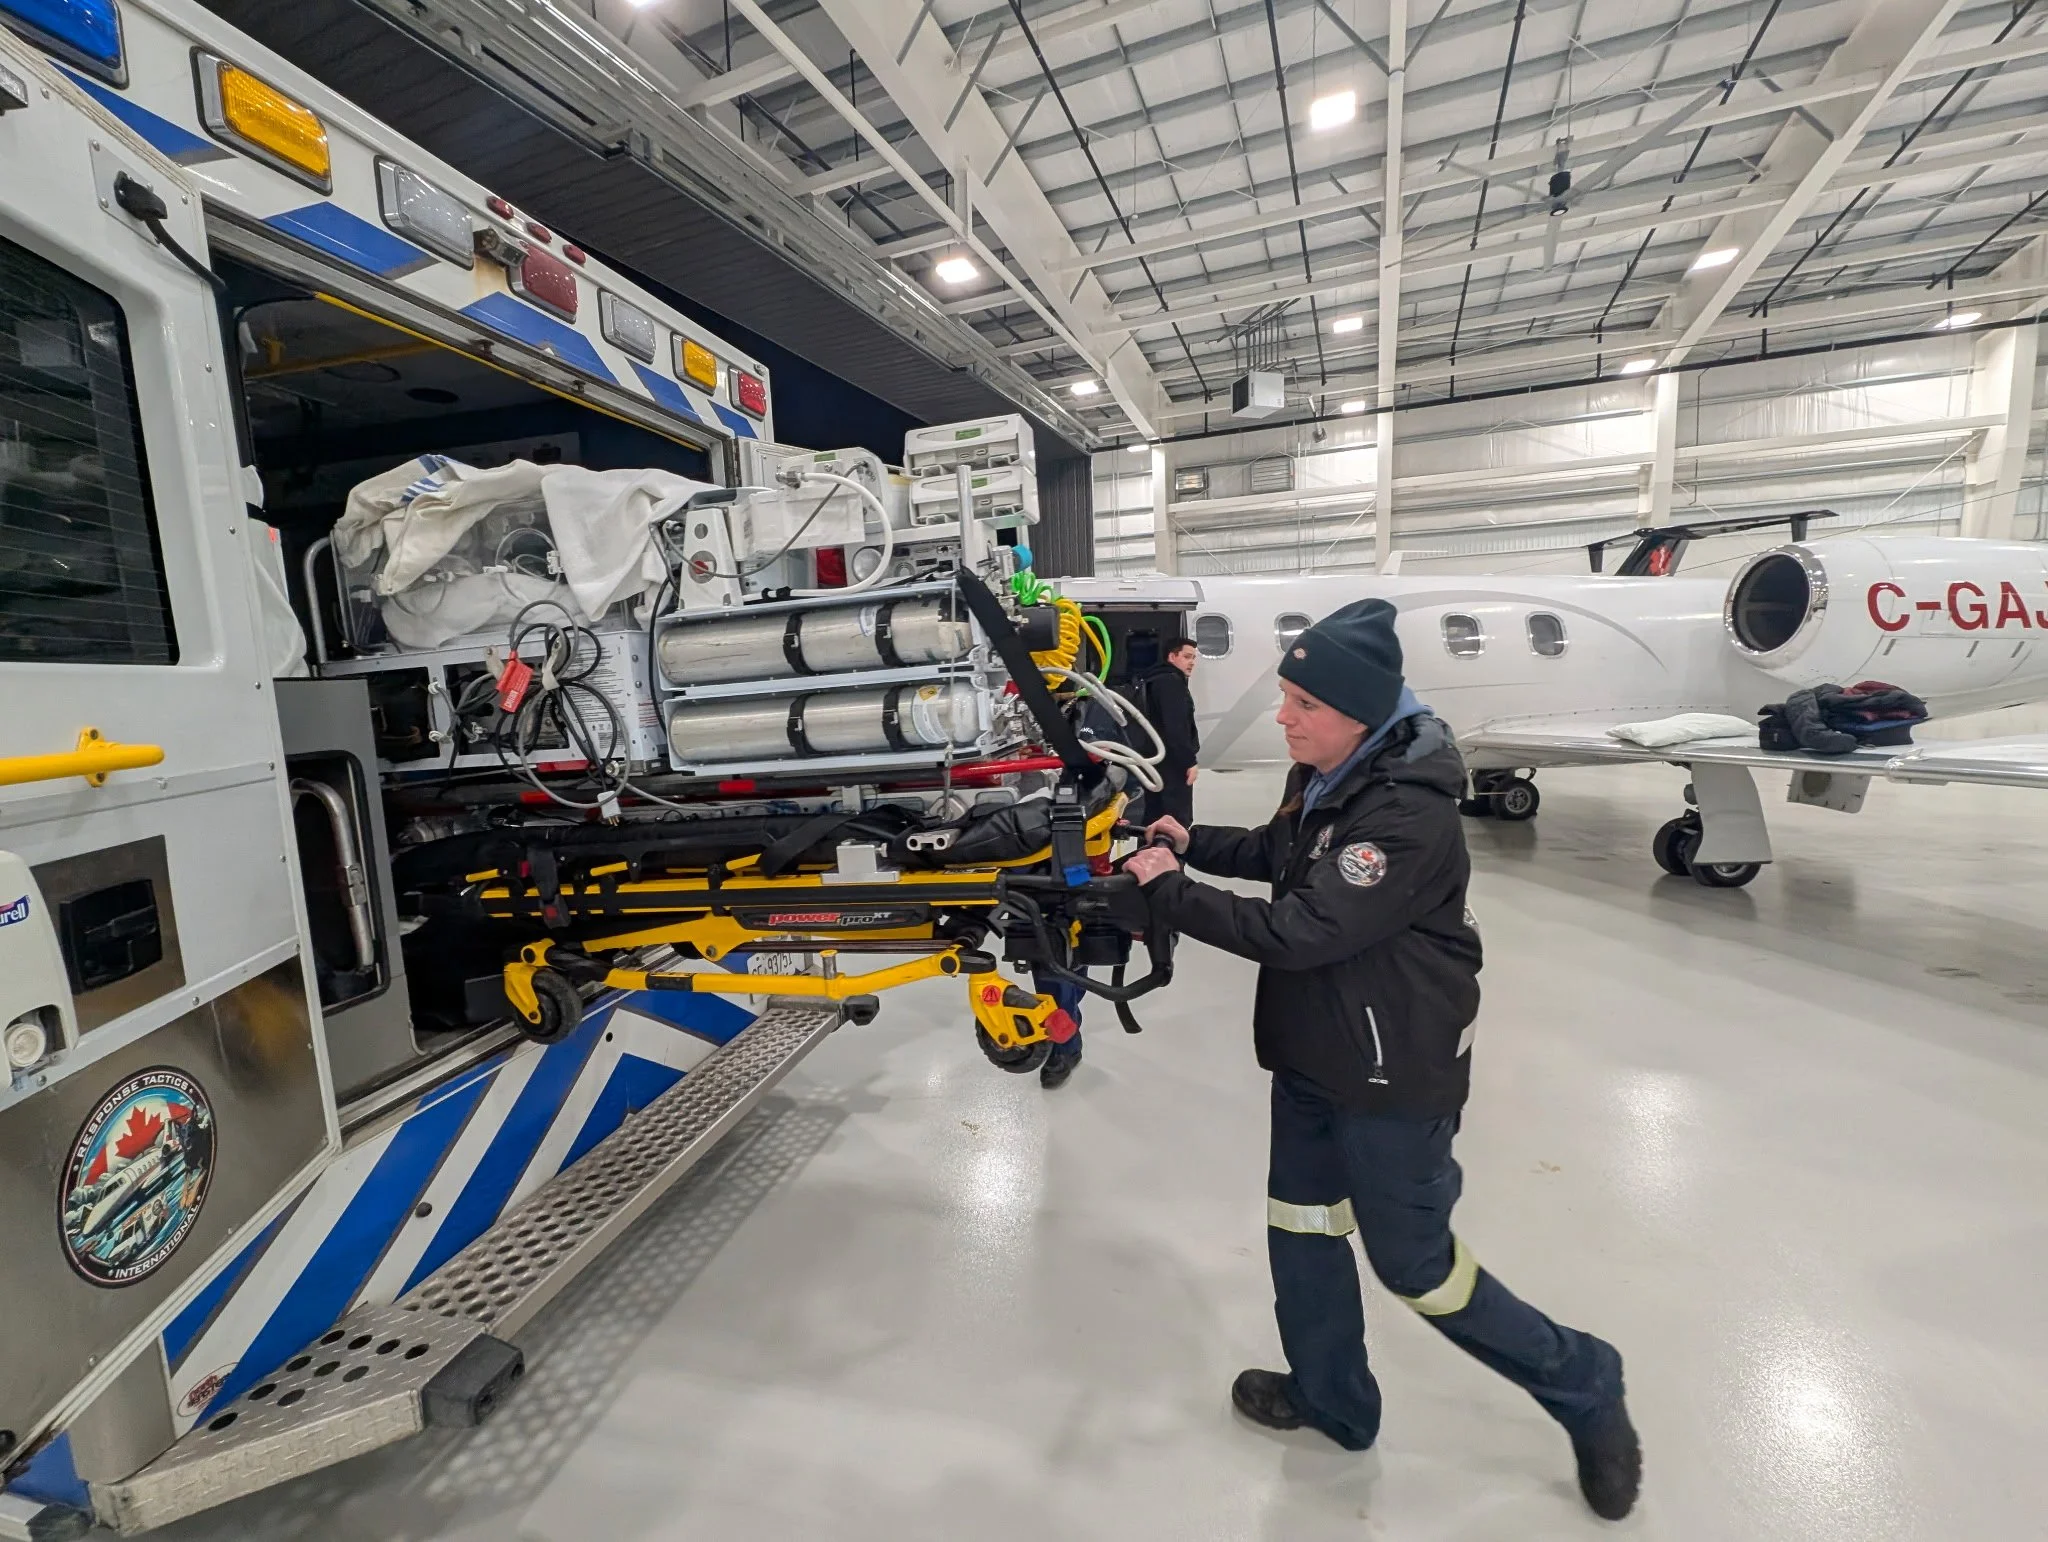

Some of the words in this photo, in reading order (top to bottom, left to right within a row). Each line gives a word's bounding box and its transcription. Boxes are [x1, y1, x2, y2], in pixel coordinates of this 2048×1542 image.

[76, 1081, 140, 1158] RESPONSE
[142, 1074, 189, 1091] TACTICS
[115, 1204, 200, 1279] INTERNATIONAL
